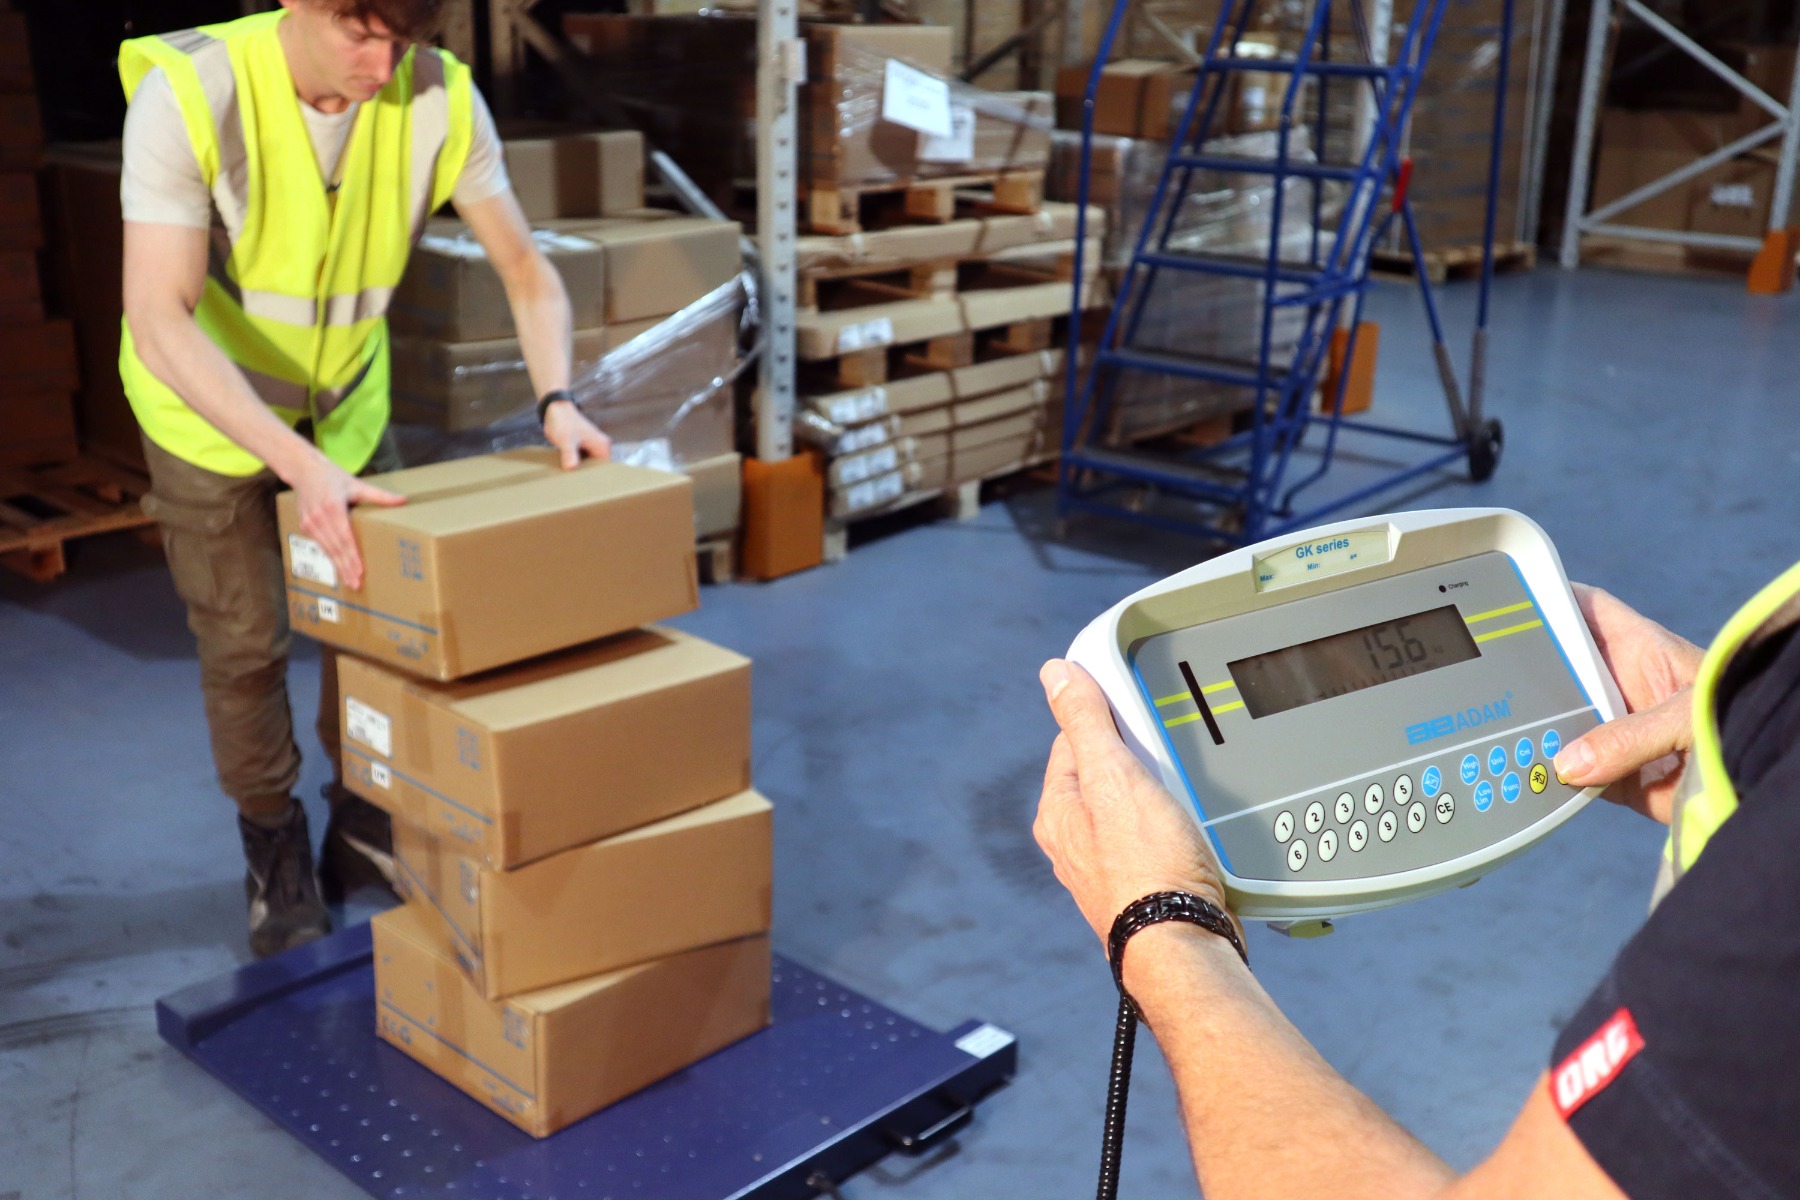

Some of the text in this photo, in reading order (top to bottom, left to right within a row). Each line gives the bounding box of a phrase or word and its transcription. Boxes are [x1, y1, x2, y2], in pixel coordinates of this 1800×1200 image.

[1295, 538, 1350, 559] GK series
[1448, 580, 1469, 590] Charging
[1456, 698, 1512, 731] ADAM
[1543, 740, 1559, 749] Print
[1462, 760, 1478, 770] High
[1491, 756, 1505, 766] Unit
[1462, 770, 1476, 779] Lim
[1503, 783, 1520, 793] Func
[1475, 797, 1489, 806] Lim
[1437, 802, 1453, 814] CE
